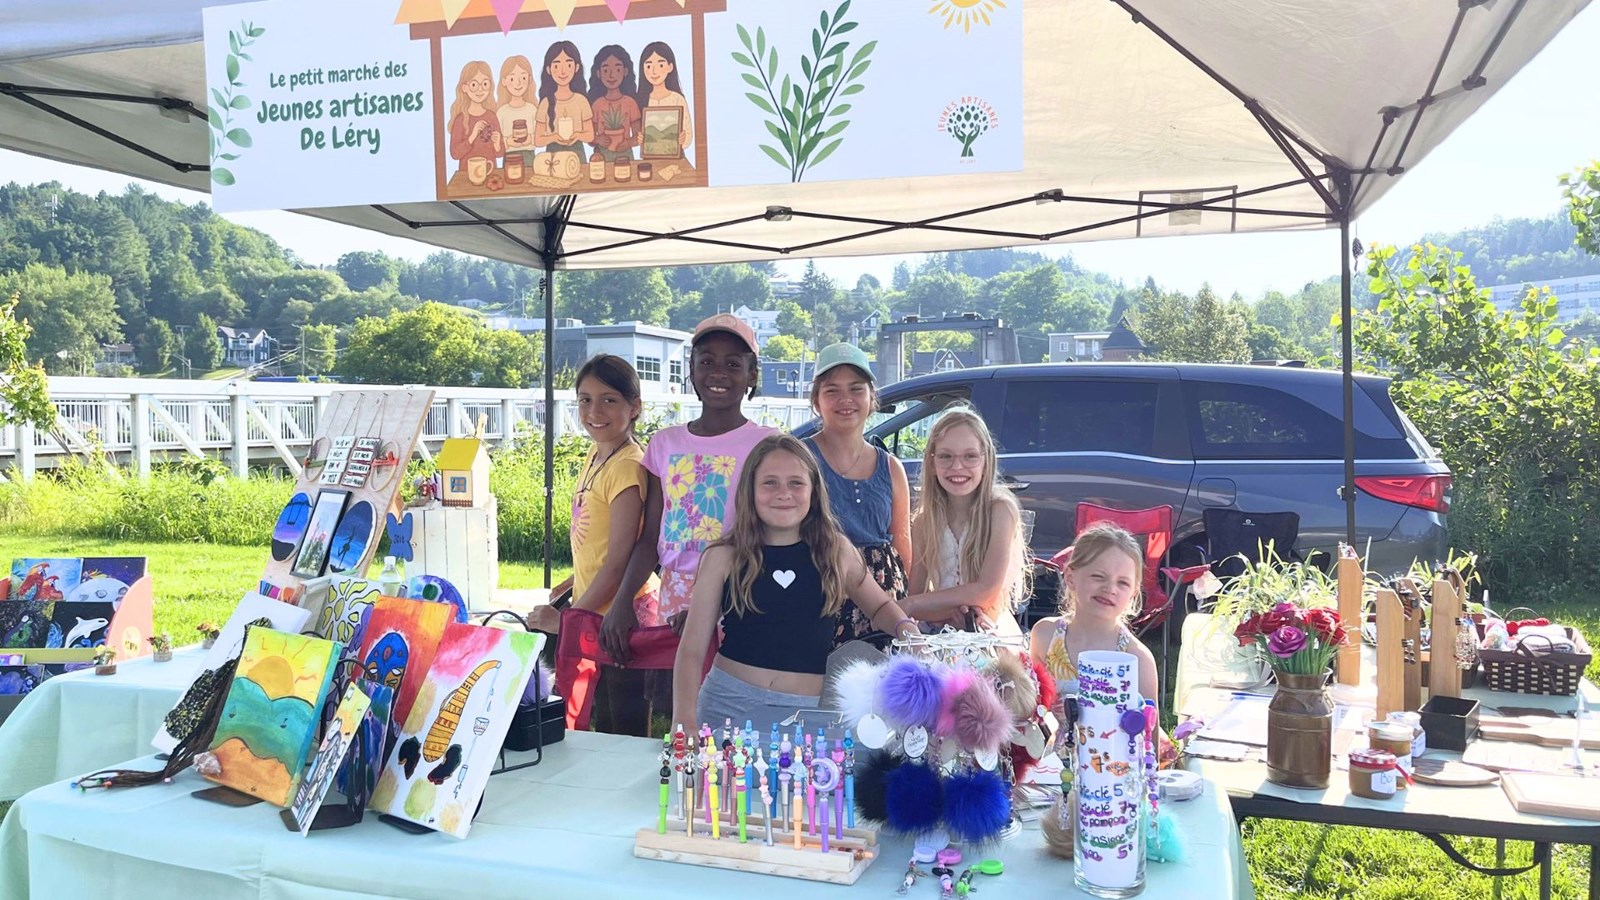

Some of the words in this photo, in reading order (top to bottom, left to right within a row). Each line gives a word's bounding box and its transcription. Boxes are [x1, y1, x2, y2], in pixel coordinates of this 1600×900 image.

[270, 72, 286, 89] Le
[290, 67, 324, 91] petit
[328, 61, 380, 84] marché
[385, 60, 408, 79] des
[257, 99, 323, 124] Jeunes
[329, 91, 424, 118] artisanes
[938, 101, 958, 132] JEUNES
[961, 96, 999, 129] ARTISANES
[300, 127, 326, 151] De
[332, 122, 381, 154] Léry
